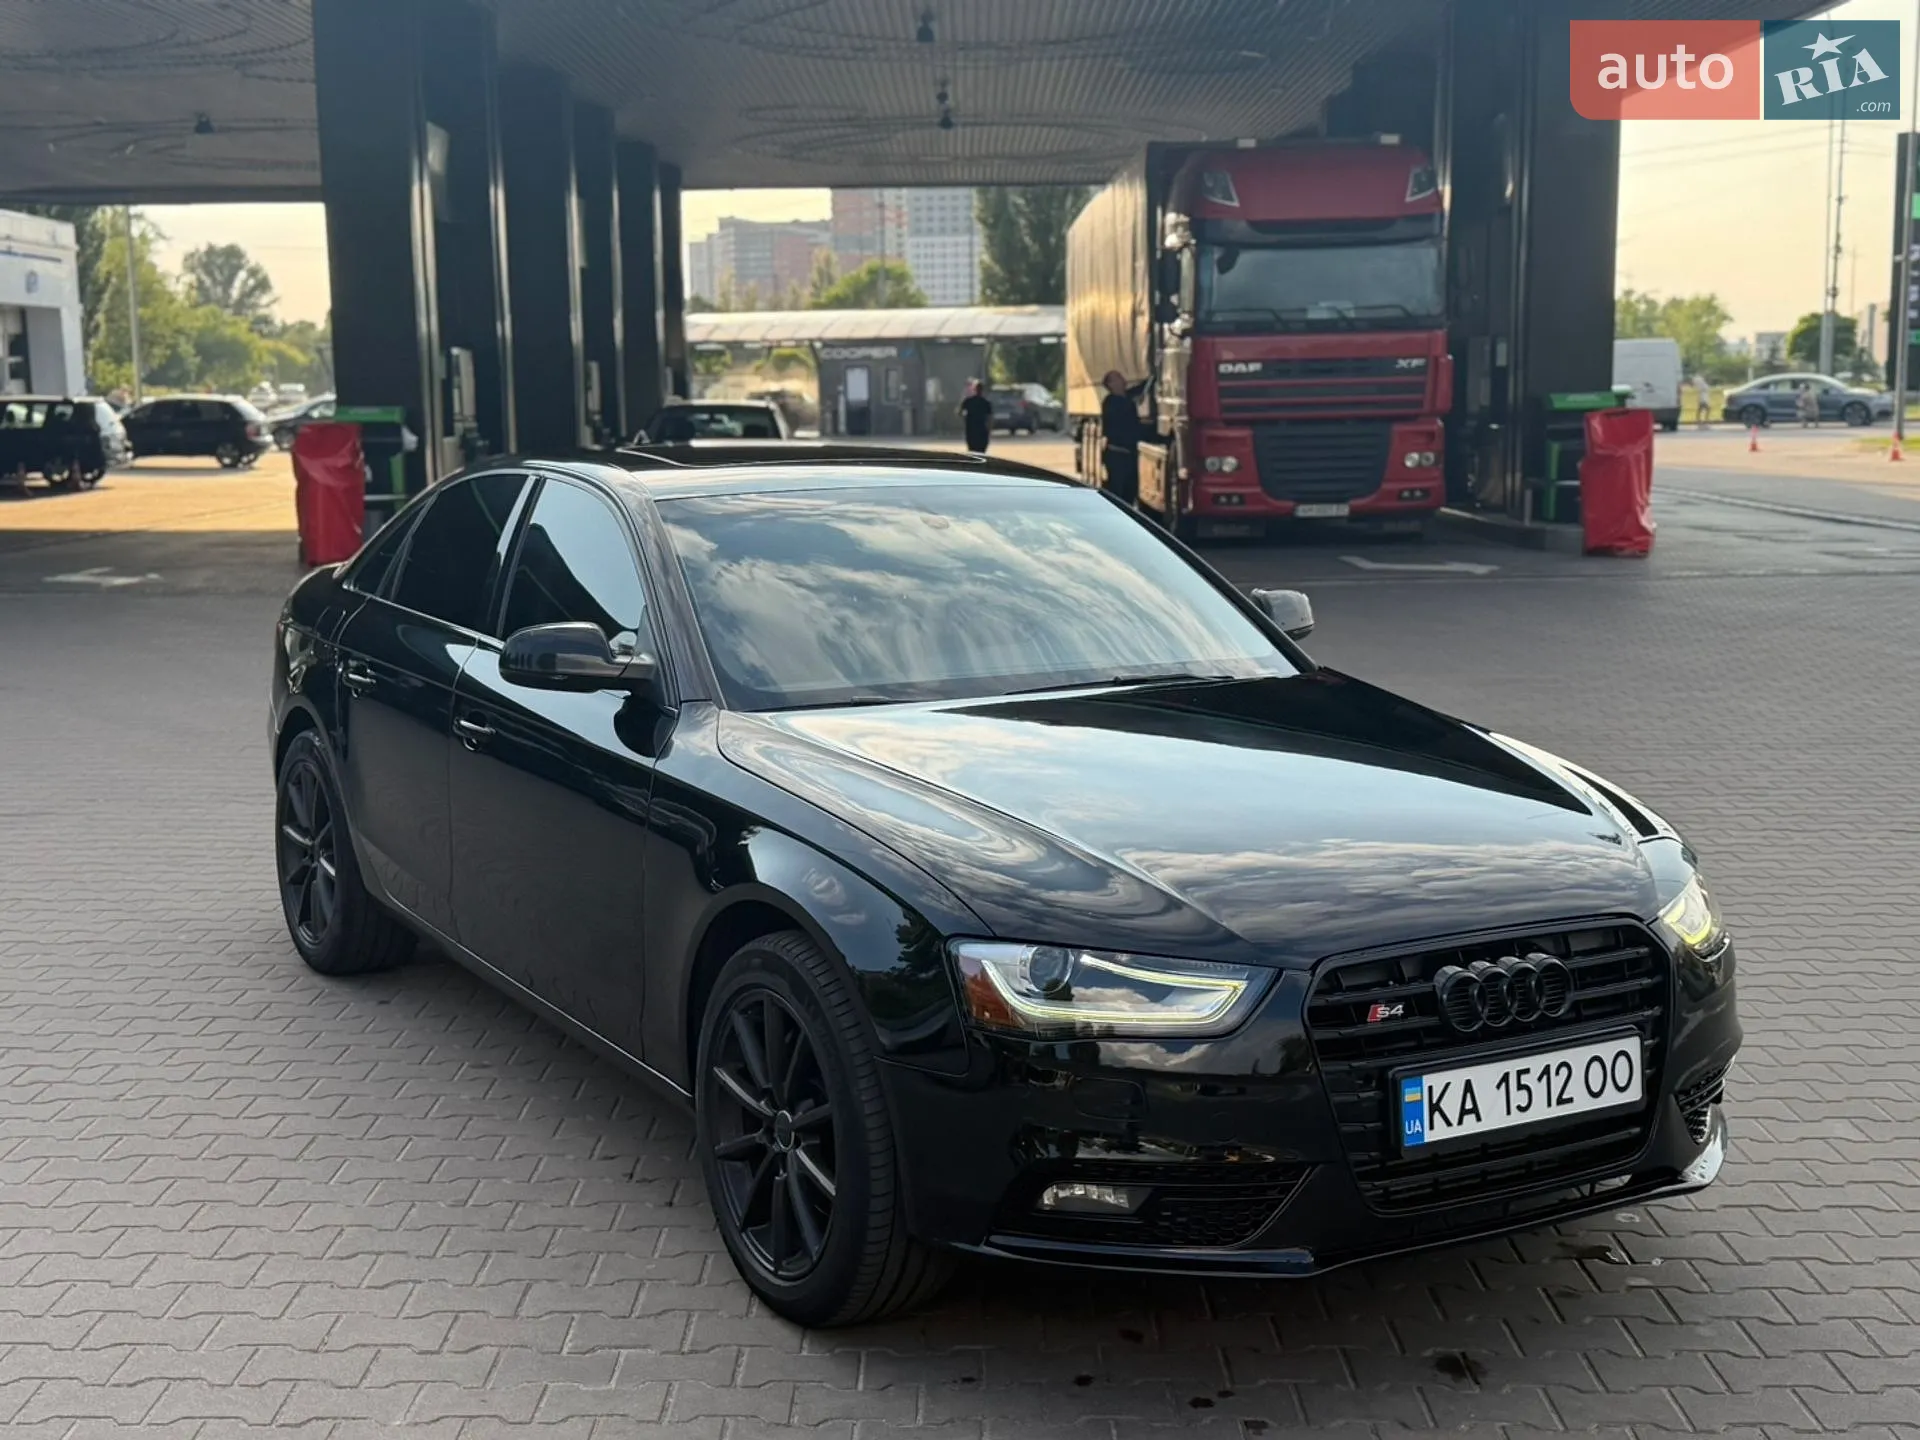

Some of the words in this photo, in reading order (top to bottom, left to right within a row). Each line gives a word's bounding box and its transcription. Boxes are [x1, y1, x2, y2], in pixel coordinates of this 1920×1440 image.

[820, 346, 898, 360] COOPER
[1218, 361, 1263, 374] DAF
[1395, 358, 1426, 369] XF
[1376, 1004, 1404, 1018] S4
[1427, 1078, 1483, 1131] KA
[1496, 1061, 1575, 1116] 1512
[1404, 1118, 1423, 1135] UA
